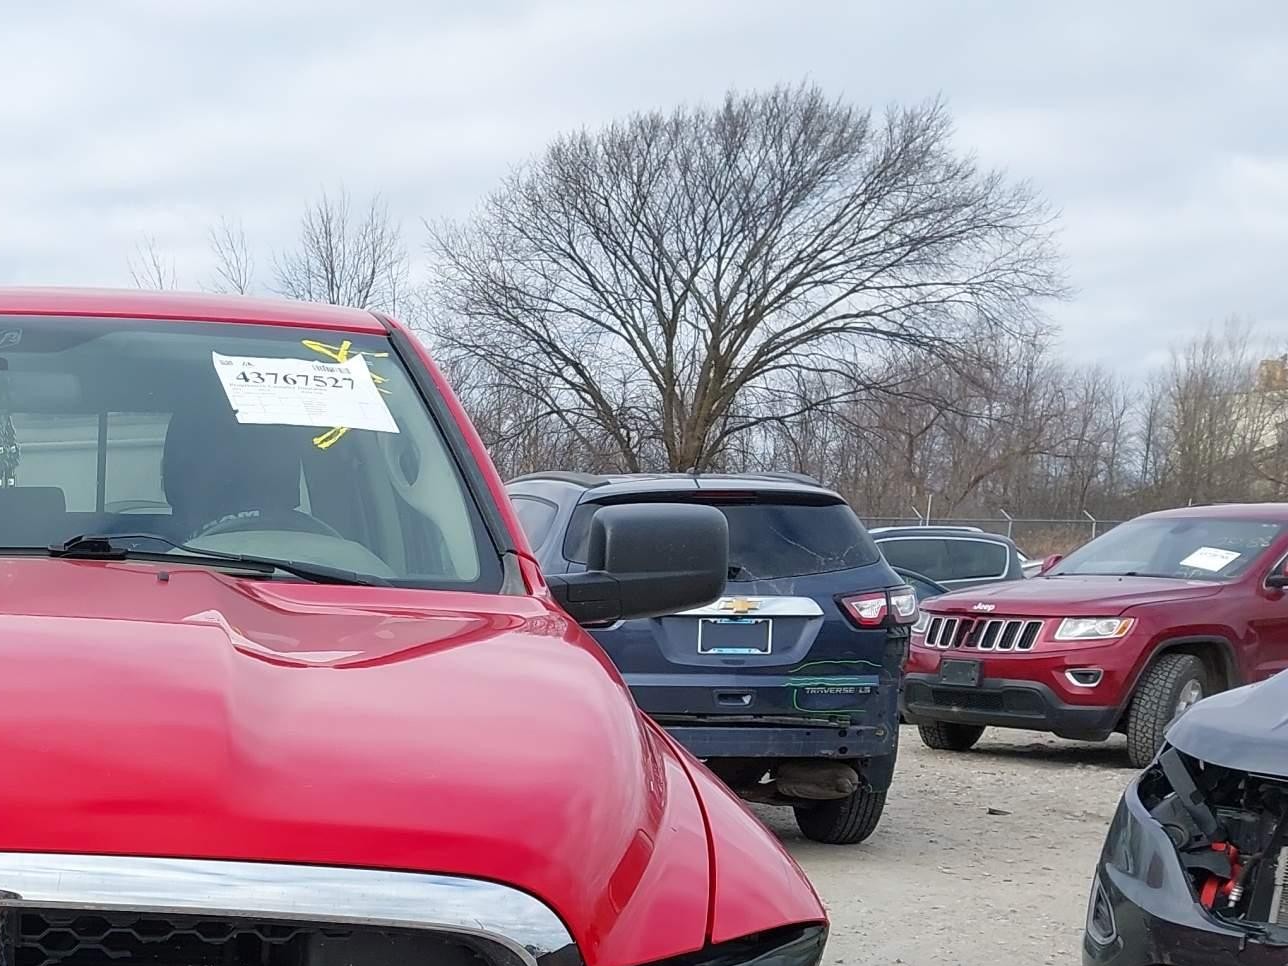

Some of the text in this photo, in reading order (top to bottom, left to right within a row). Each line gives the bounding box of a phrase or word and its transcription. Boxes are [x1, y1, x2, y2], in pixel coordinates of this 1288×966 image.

[235, 370, 354, 390] 43767527
[973, 602, 996, 612] Jeep
[804, 686, 856, 694] TRAVERSE
